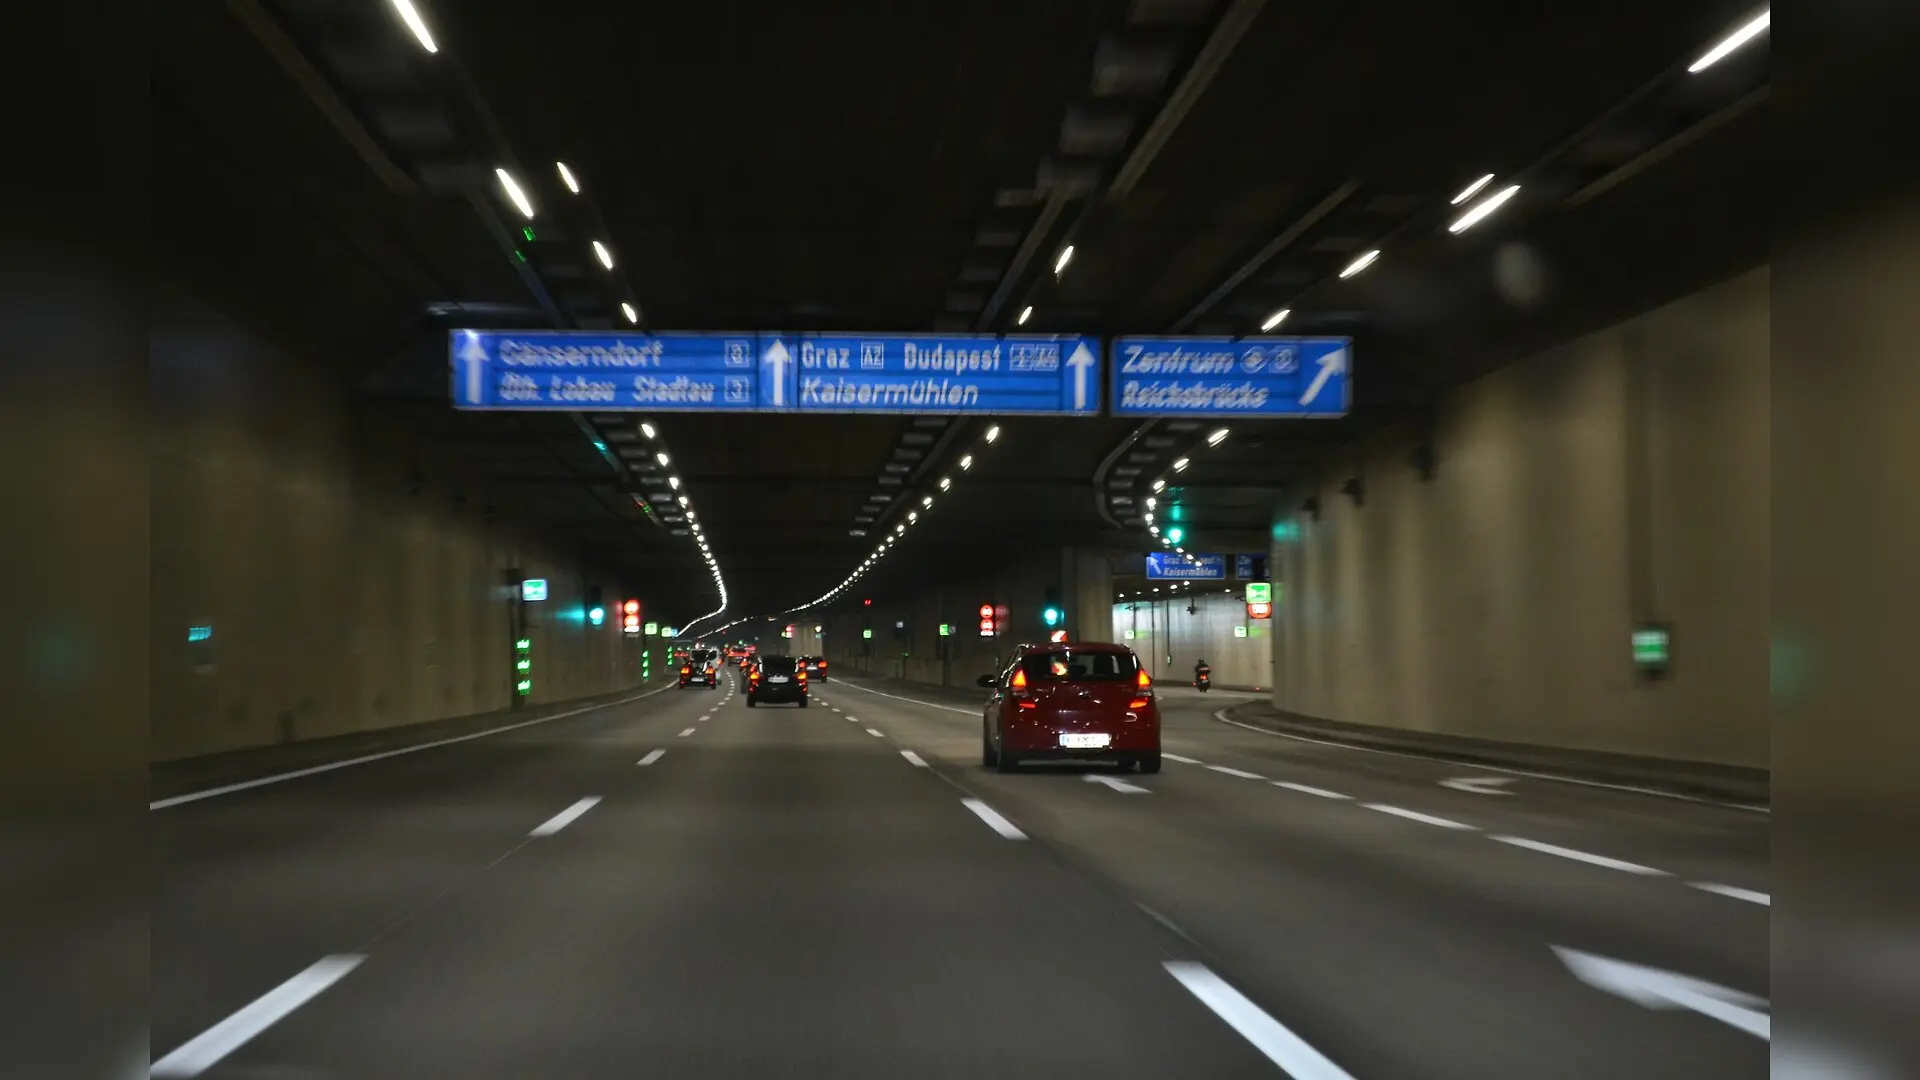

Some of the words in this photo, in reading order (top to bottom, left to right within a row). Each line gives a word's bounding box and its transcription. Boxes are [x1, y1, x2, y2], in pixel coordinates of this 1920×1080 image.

[801, 342, 851, 369] Graz
[862, 344, 883, 367] A2
[904, 342, 1001, 375] Budapest
[1121, 345, 1235, 373] Zentrum
[802, 376, 979, 406] Kaisermühlen
